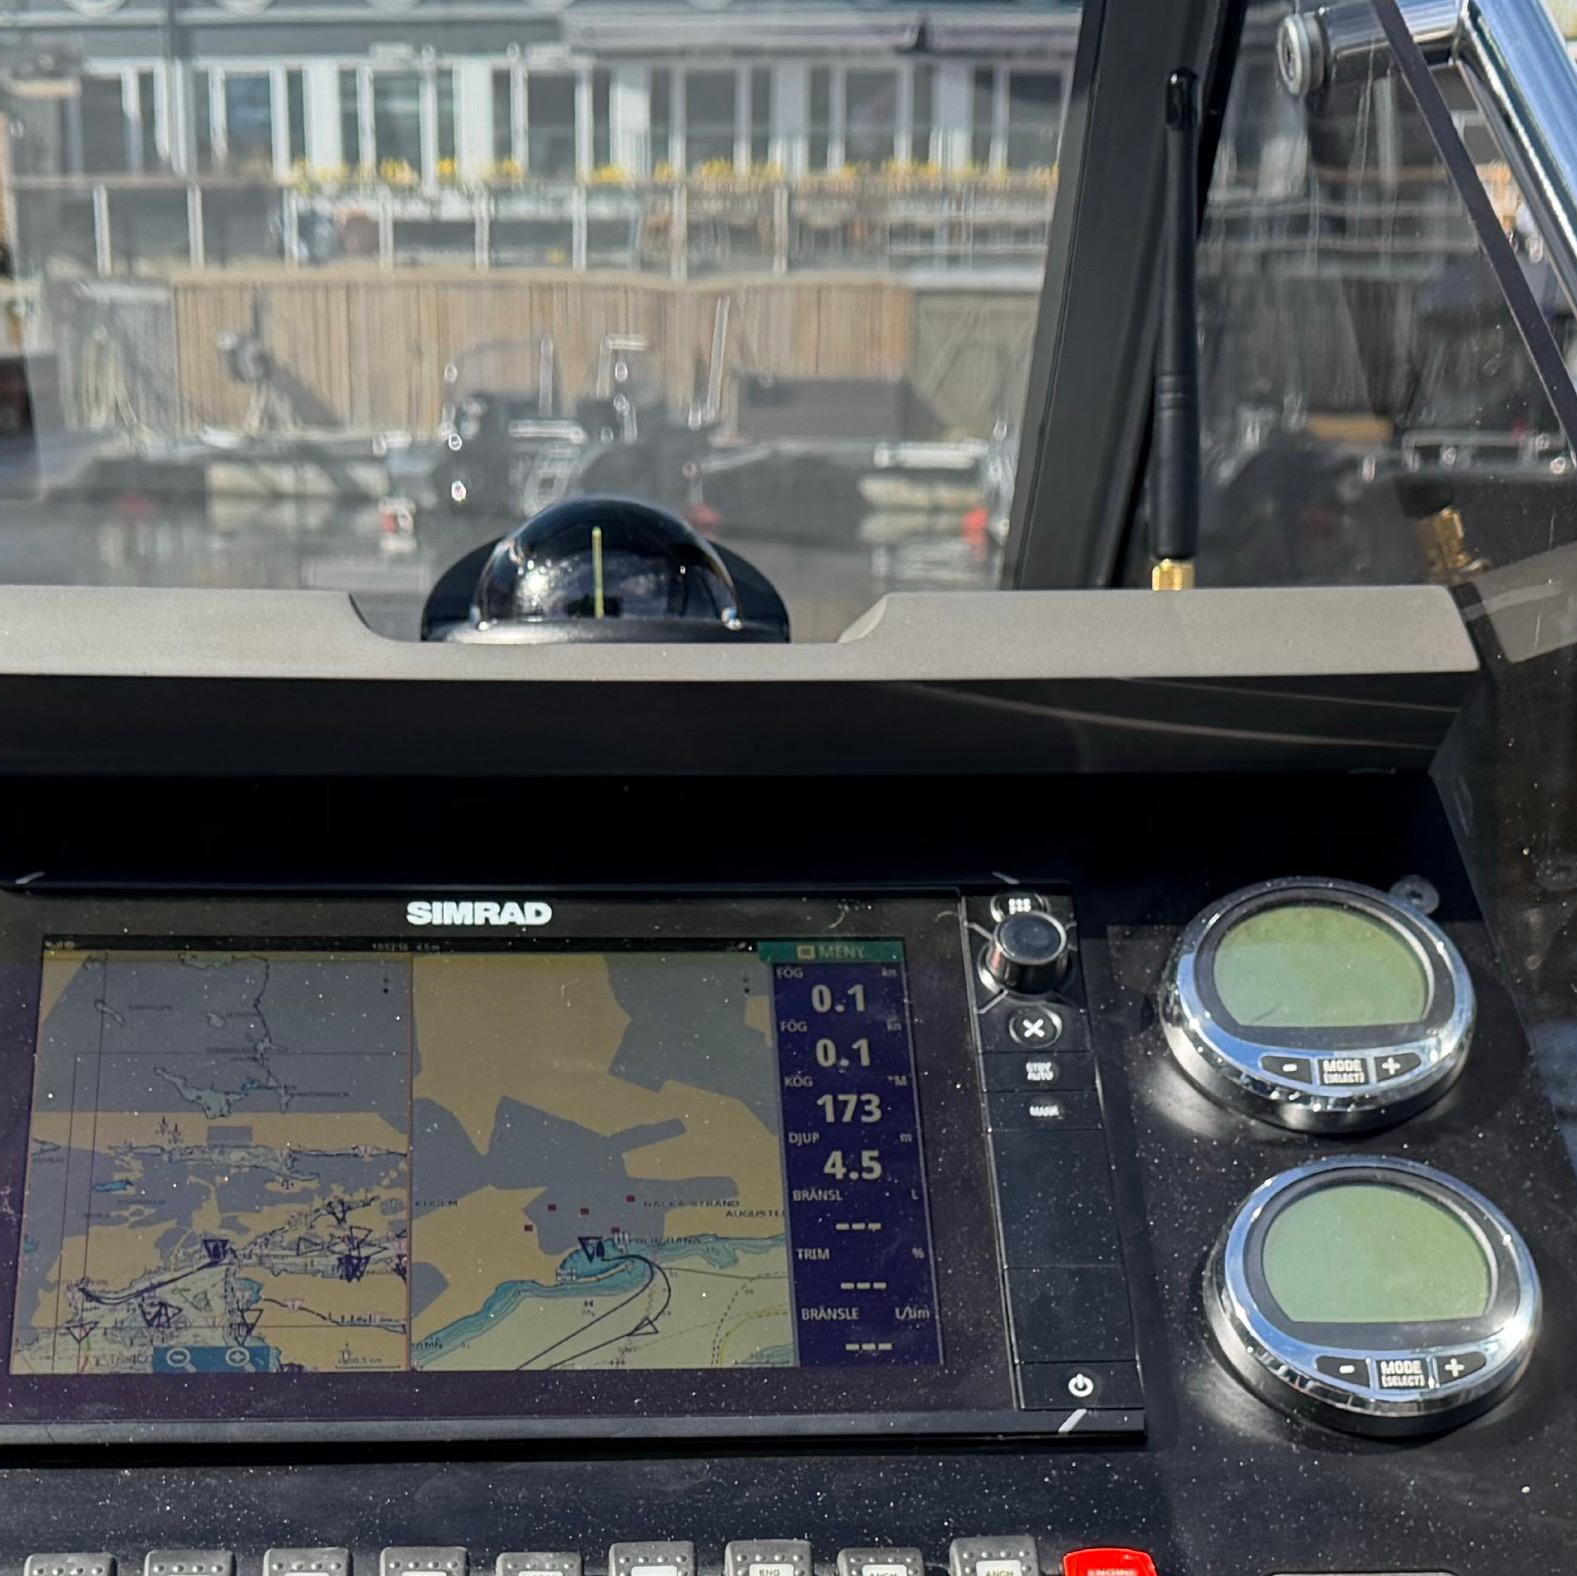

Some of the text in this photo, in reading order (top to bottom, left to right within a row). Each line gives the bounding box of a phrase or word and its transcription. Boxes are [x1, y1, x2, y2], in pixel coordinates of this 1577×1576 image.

[406, 901, 553, 925] SIMRAD
[819, 945, 865, 958] MENY
[811, 984, 866, 1013] 0.1
[816, 1038, 870, 1067] 0.1
[1323, 1059, 1362, 1072] MODE
[816, 1094, 882, 1123] 173
[788, 1133, 820, 1146] DJUP
[824, 1150, 882, 1180] 4.5
[797, 1247, 830, 1260] TRIM
[1380, 1360, 1422, 1374] MODE
[759, 1569, 780, 1576] ENG
